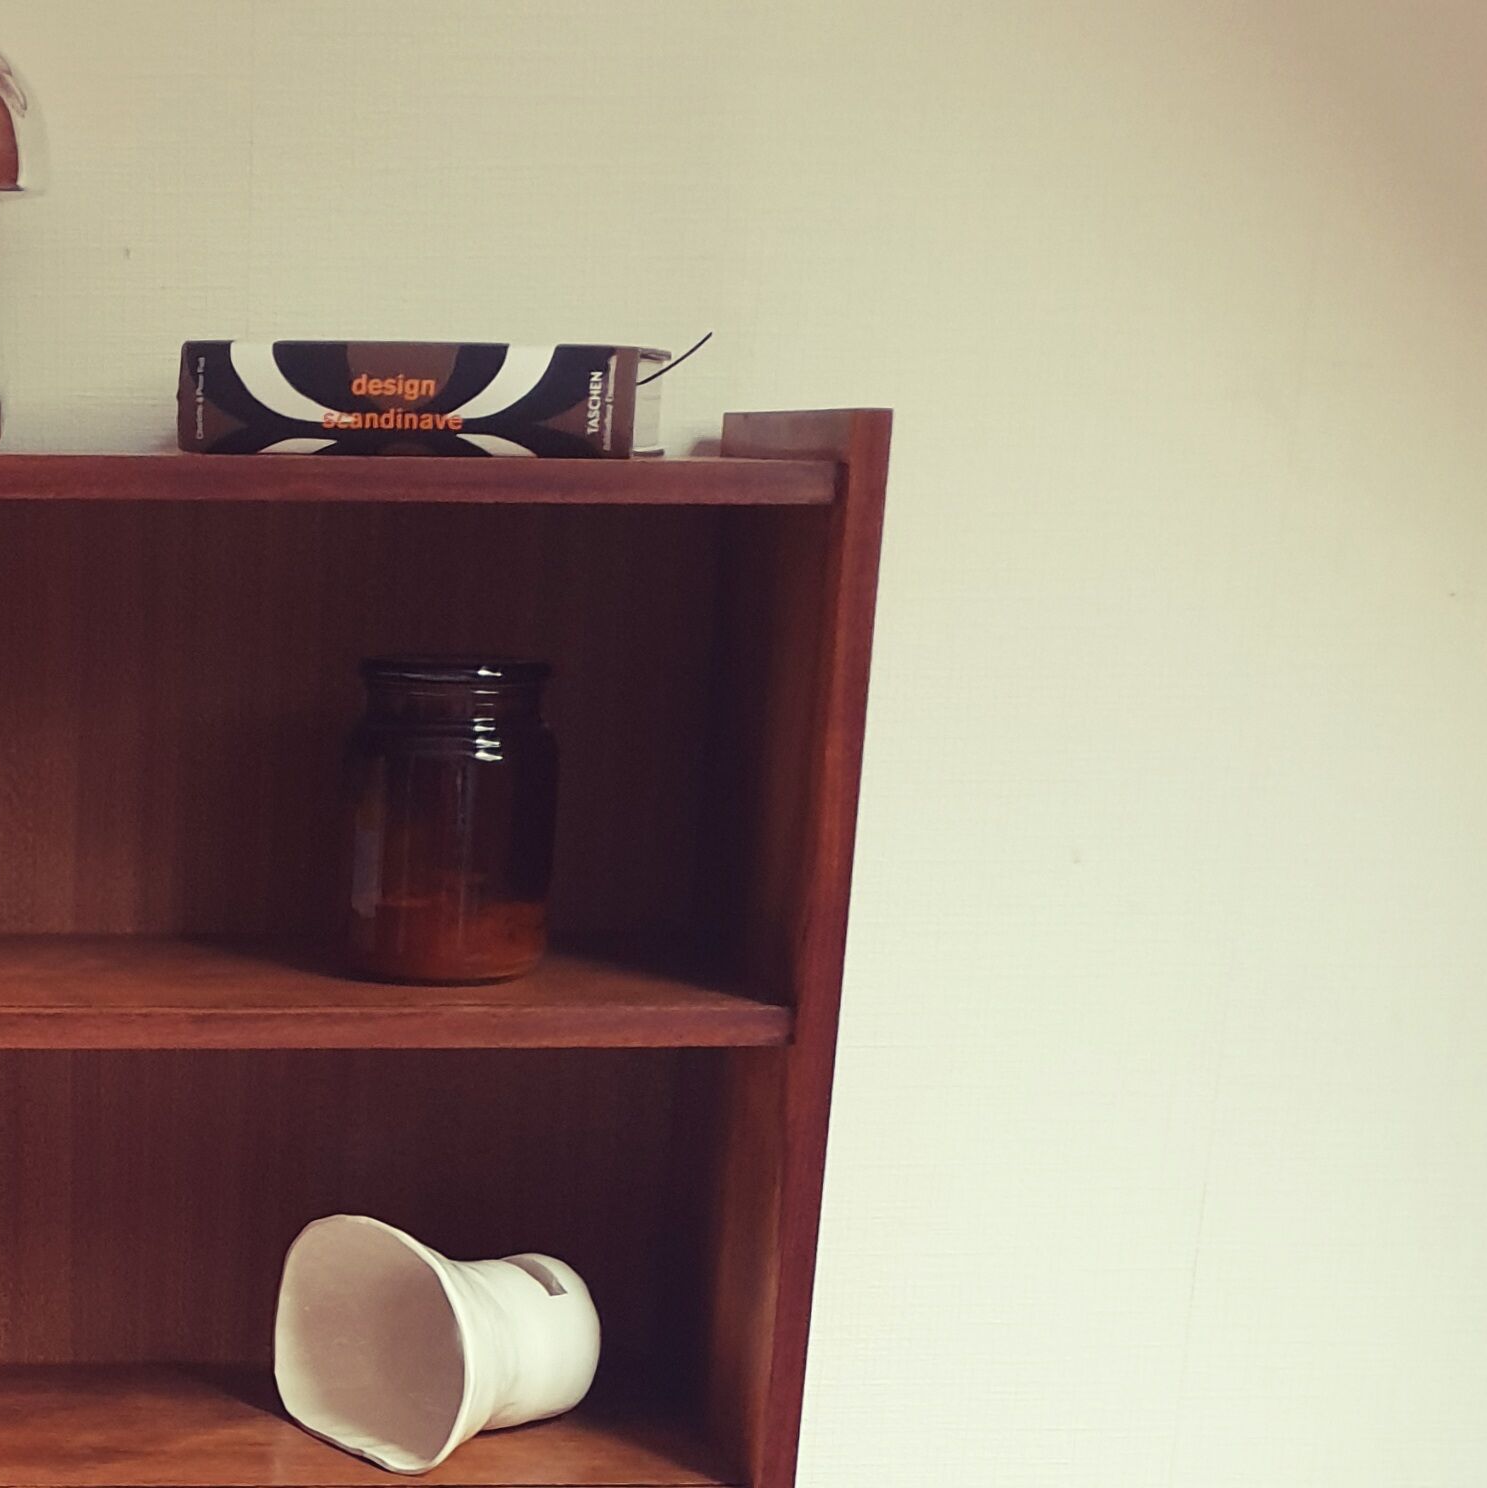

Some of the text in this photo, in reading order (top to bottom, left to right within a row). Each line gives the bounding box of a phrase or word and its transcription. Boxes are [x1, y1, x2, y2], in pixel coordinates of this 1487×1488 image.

[351, 374, 436, 400] design
[587, 371, 603, 434] TASCHEN
[322, 408, 463, 430] scandinave
